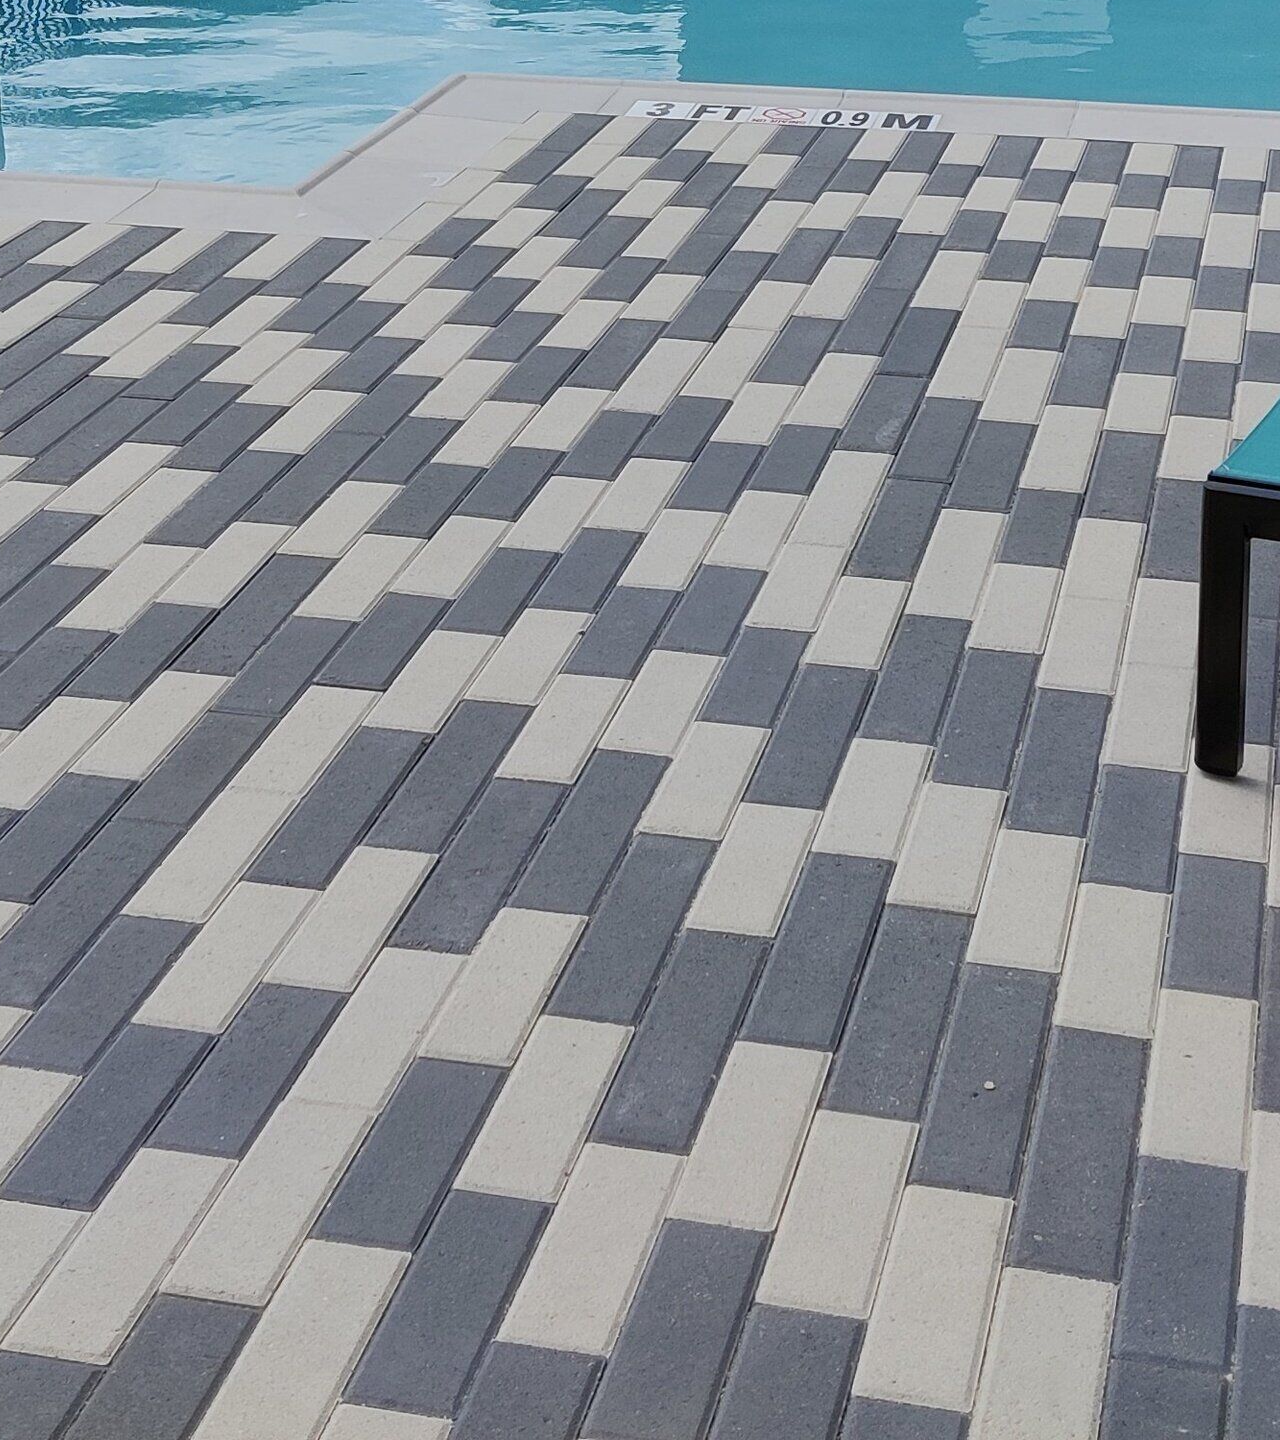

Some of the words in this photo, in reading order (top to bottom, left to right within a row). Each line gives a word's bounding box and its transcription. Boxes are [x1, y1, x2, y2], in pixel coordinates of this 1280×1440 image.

[646, 103, 675, 117] 3
[690, 105, 751, 121] FT
[821, 111, 870, 127] 0.9
[880, 113, 934, 130] M
